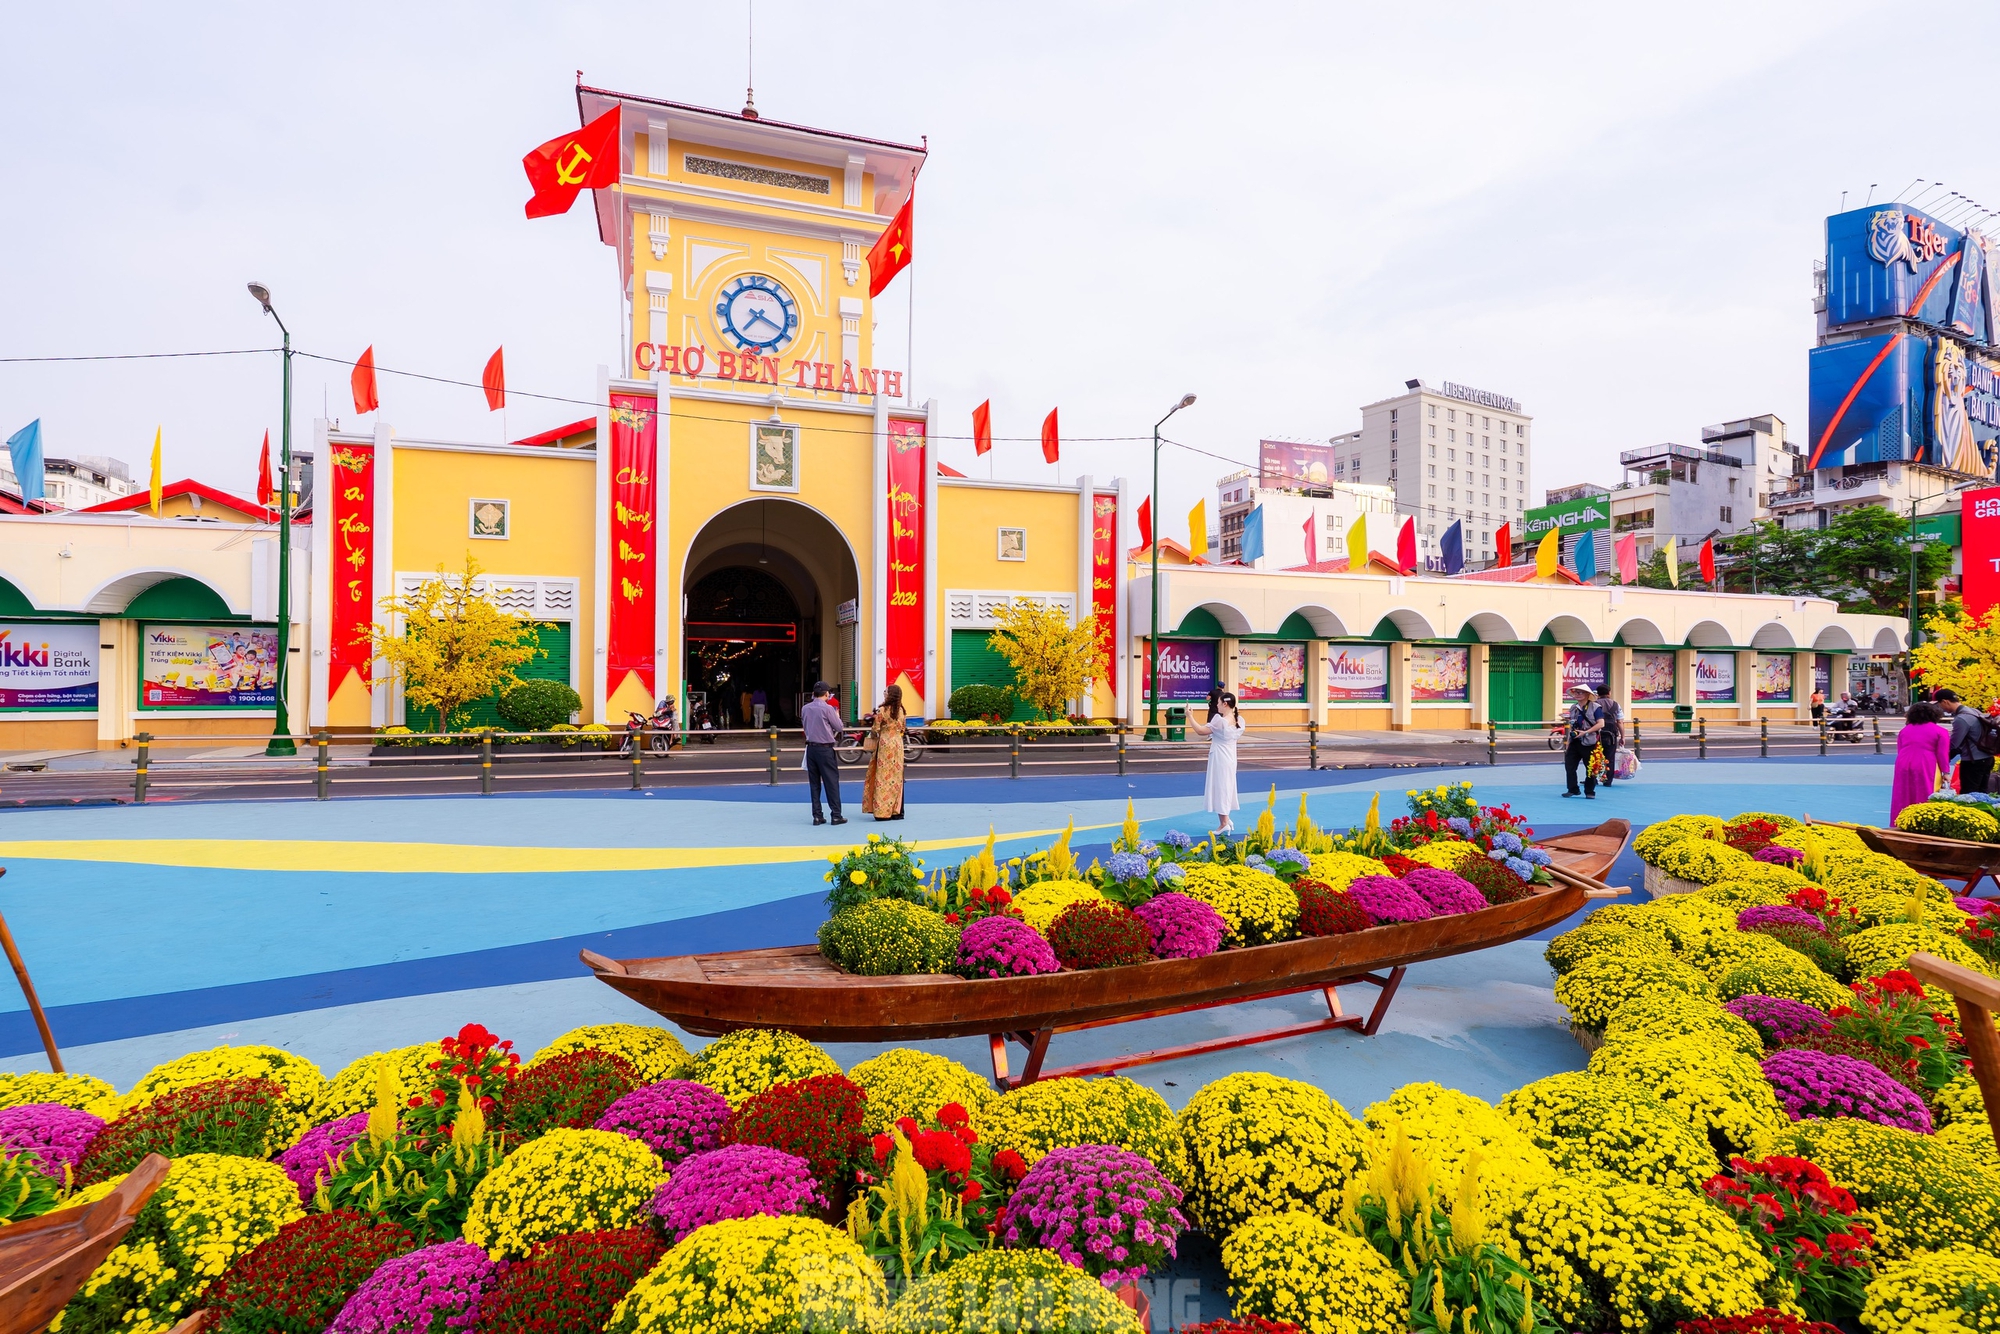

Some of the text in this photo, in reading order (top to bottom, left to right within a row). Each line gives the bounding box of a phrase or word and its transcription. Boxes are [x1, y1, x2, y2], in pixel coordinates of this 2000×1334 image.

[1907, 214, 1948, 261] Tiger
[750, 276, 767, 289] 12
[716, 303, 729, 316] 9
[787, 314, 797, 328] 3
[635, 341, 903, 397] CHỢ BẾN THÀNH
[616, 467, 650, 485] Chúc
[887, 482, 922, 517] Happy
[615, 501, 652, 533] Mừng
[338, 513, 370, 550] Xuân
[1093, 527, 1112, 542] Chợ
[619, 539, 646, 565] Năm
[891, 559, 918, 592] Year
[890, 591, 918, 607] 2026
[0, 629, 48, 667] kki
[151, 631, 175, 643] Vikki
[54, 658, 91, 667] Bank
[1328, 650, 1364, 674] Vikki
